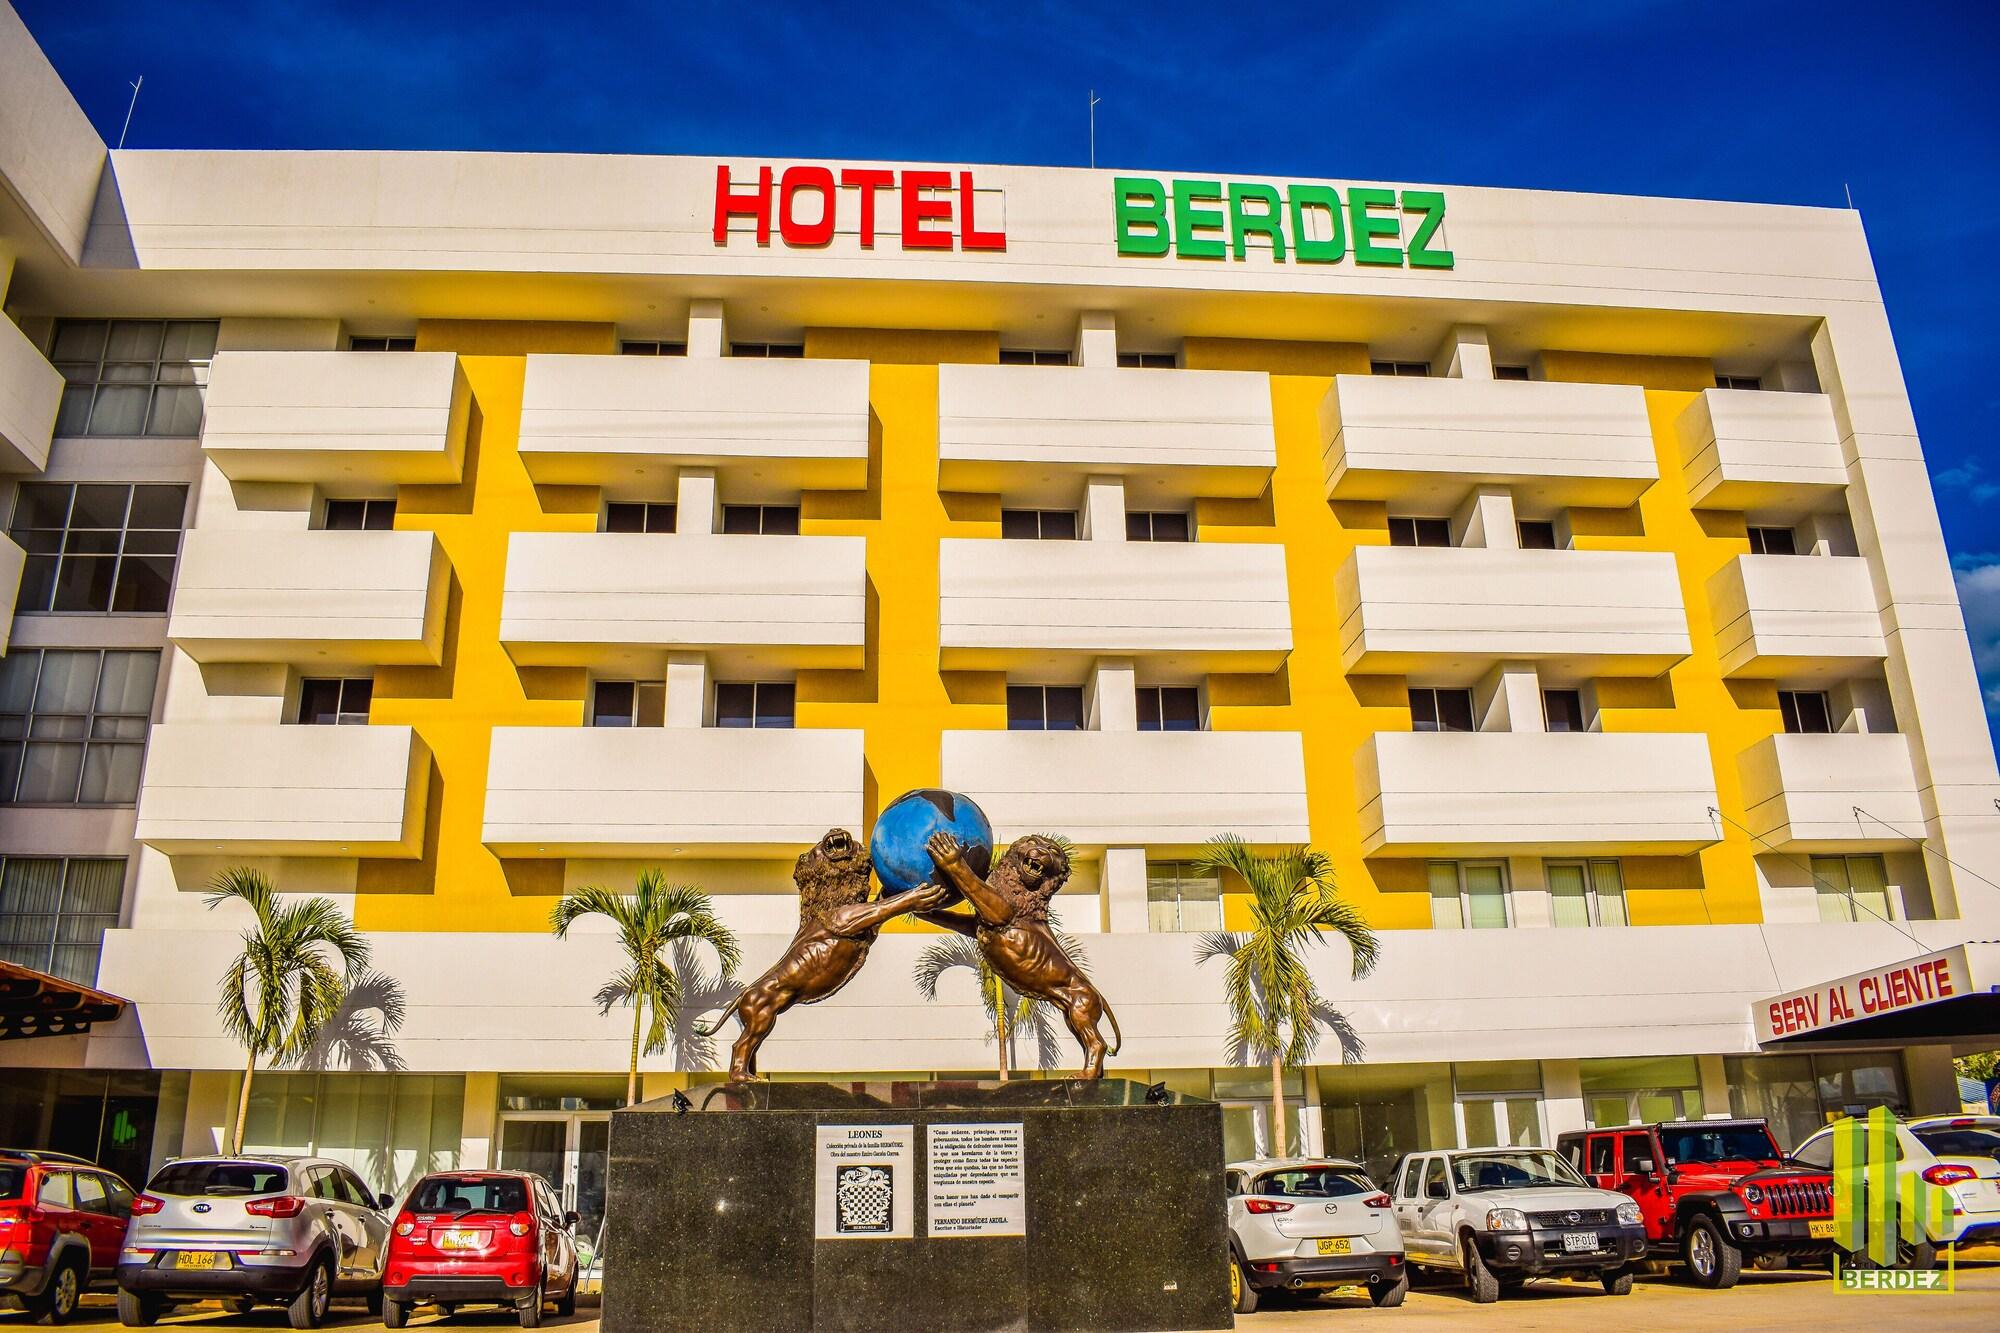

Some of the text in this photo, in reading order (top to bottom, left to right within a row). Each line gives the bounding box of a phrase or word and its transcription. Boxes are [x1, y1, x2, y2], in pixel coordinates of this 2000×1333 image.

[713, 165, 1455, 269] HOTEL BERDEZ
[1769, 958, 1953, 1035] SERV AL CLIENTE
[848, 1130, 883, 1138] LEONES
[1319, 1239, 1349, 1251] JGP 652
[1565, 1234, 1597, 1246] STP 010
[178, 1255, 213, 1265] HDL 166
